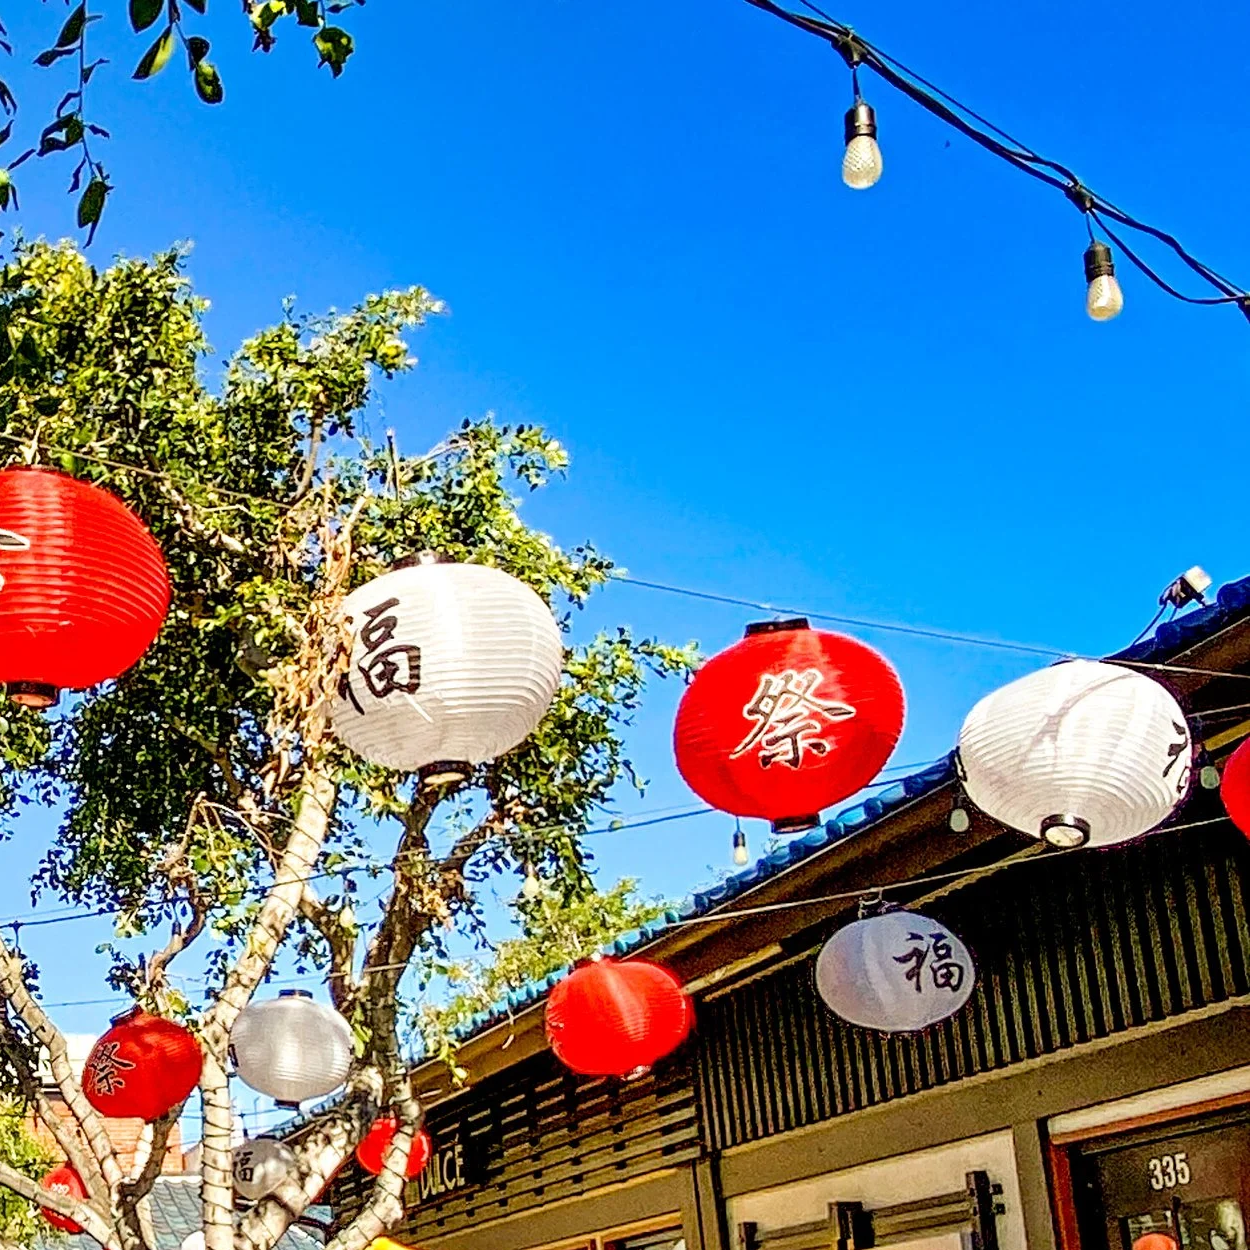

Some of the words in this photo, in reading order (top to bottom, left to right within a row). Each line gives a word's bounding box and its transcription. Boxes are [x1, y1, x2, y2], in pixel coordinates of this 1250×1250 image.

[729, 668, 857, 770] 祭
[893, 931, 964, 993] 福
[87, 1041, 136, 1096] 祭
[421, 1144, 466, 1200] DULCE
[1149, 1152, 1191, 1191] 335
